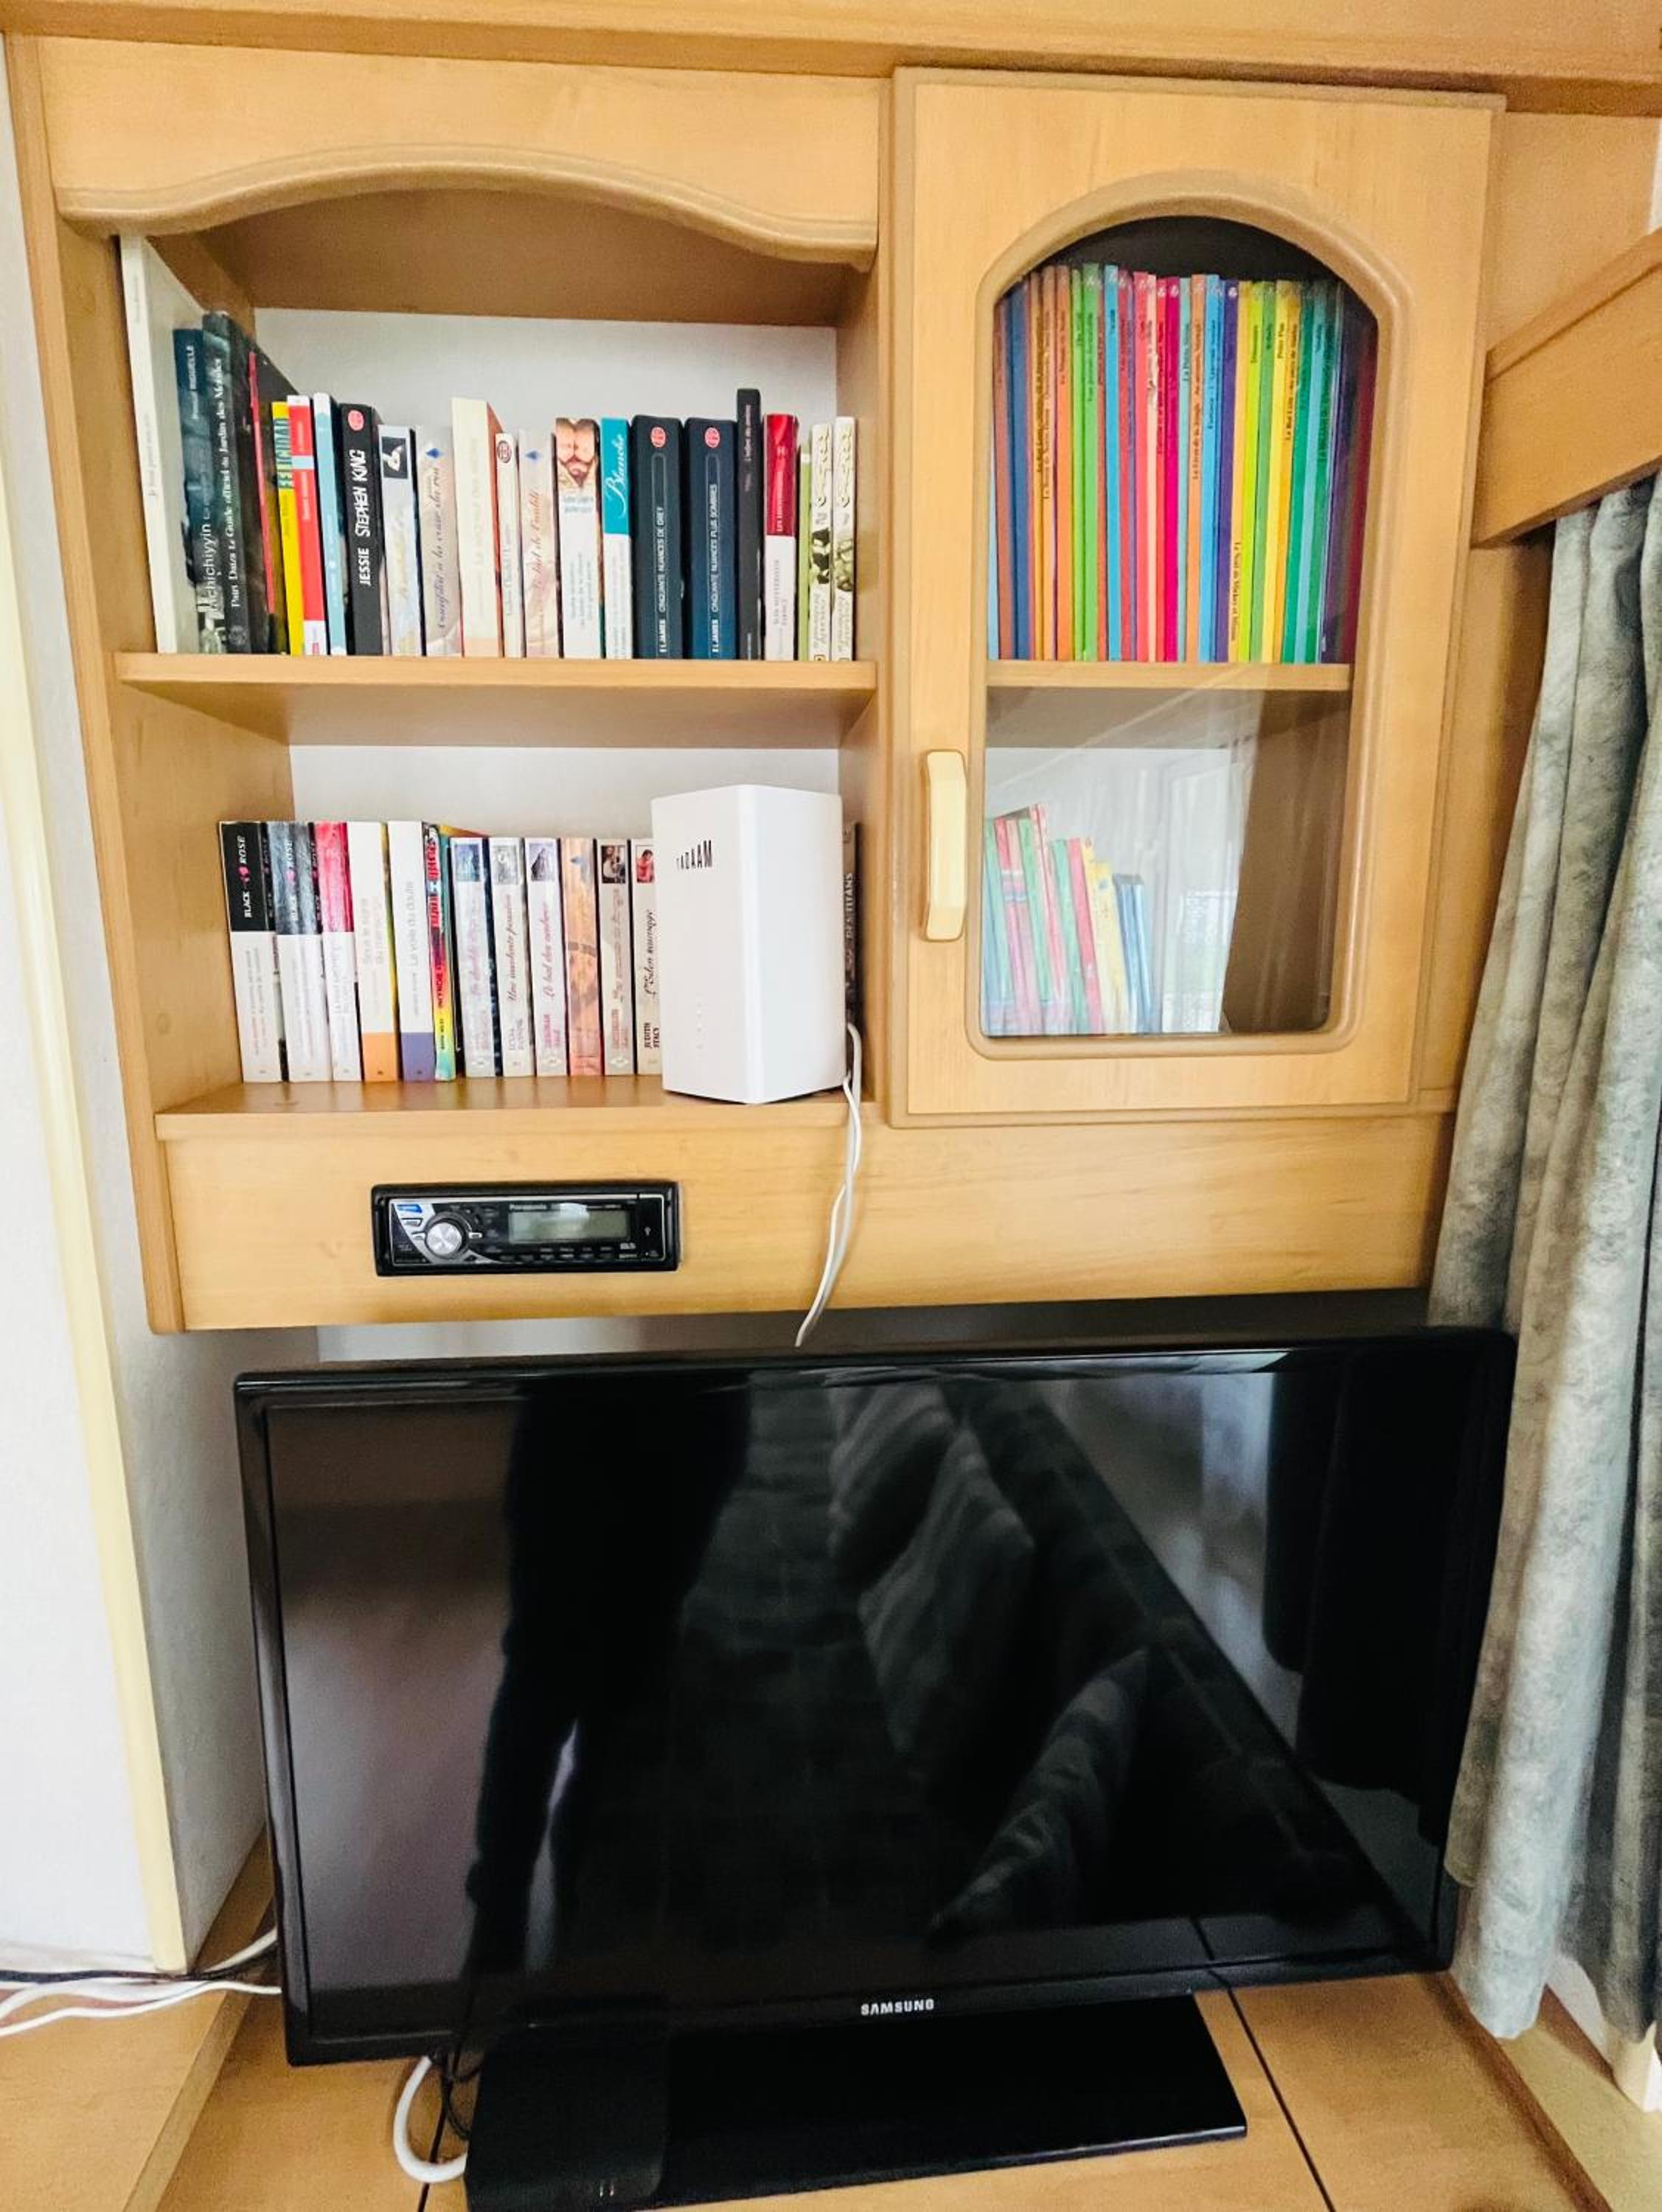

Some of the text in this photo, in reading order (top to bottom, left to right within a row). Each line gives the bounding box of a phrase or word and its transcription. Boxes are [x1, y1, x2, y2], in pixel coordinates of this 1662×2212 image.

[216, 401, 226, 420] des
[218, 422, 229, 453] Jardin
[220, 470, 232, 504] officiel
[604, 434, 628, 519] Blanche
[223, 506, 234, 538] Guide
[349, 449, 372, 587] JESSIE STEPHEN KING
[657, 527, 664, 538] DE
[709, 520, 717, 538] PLUS
[236, 835, 252, 919] BLACK ROSE
[843, 873, 853, 913] TITANS
[644, 1023, 652, 1049] JUDITH
[860, 1998, 934, 2016] SAMSUNG
